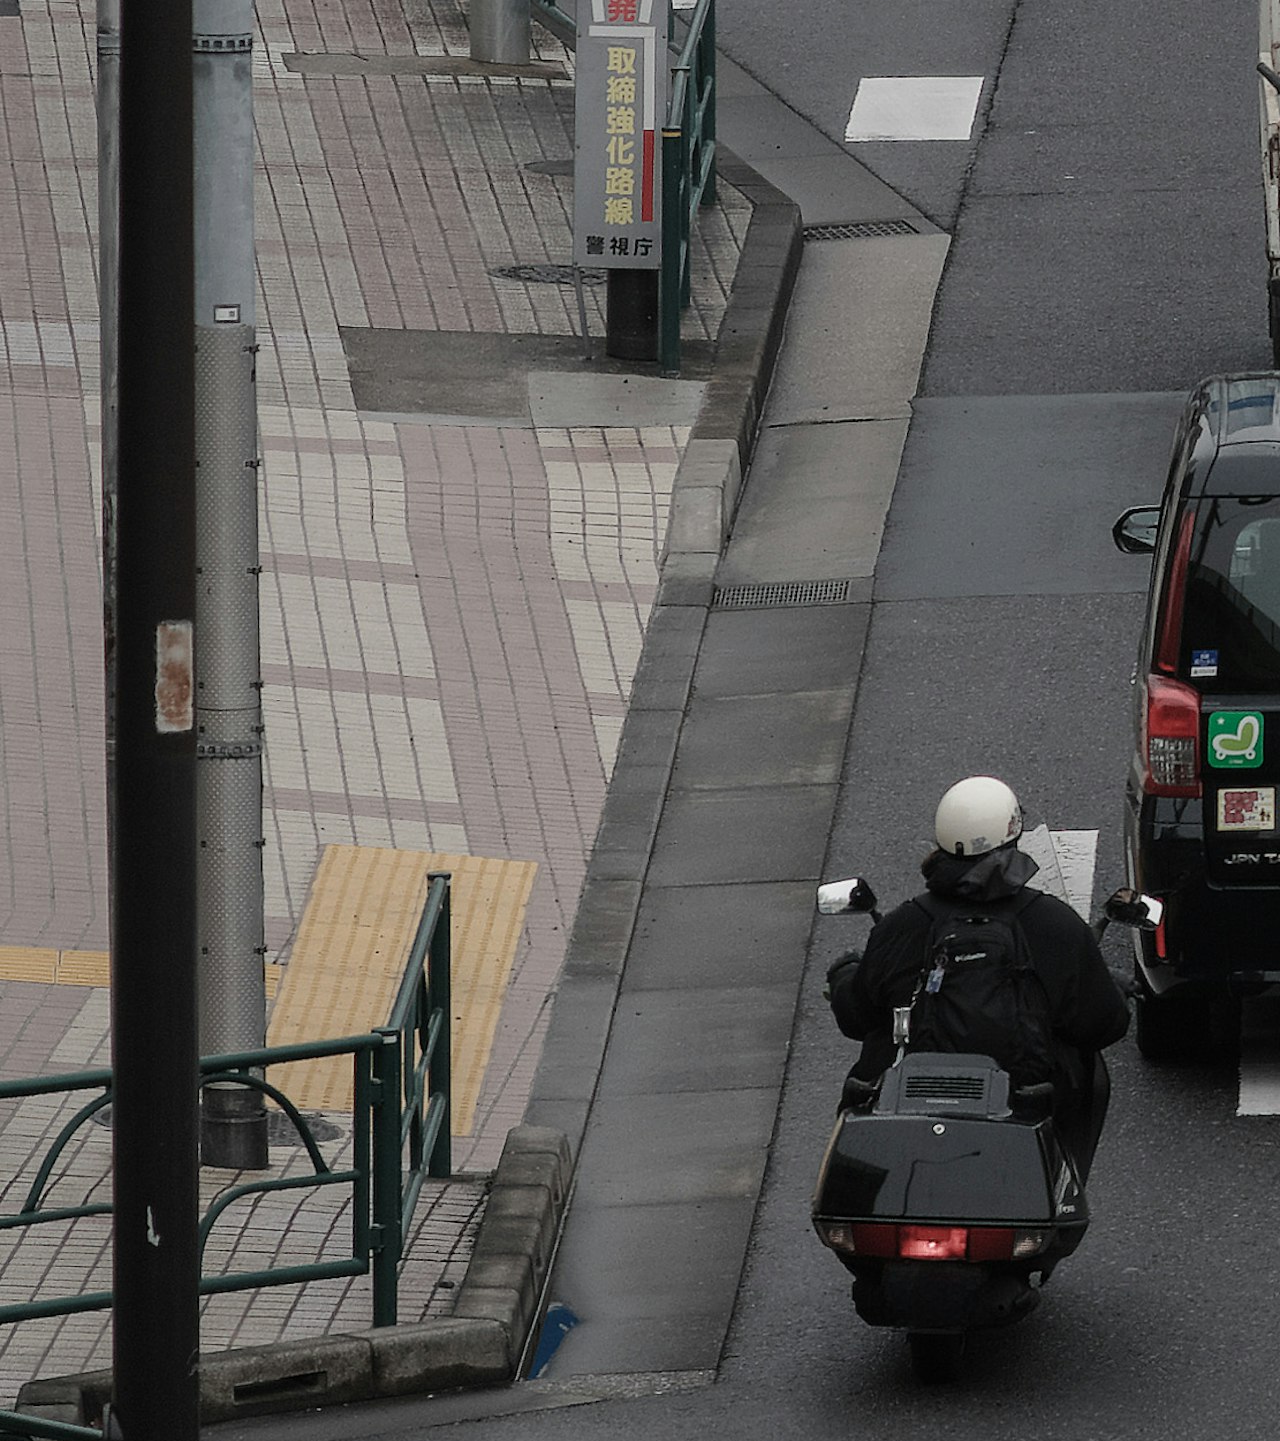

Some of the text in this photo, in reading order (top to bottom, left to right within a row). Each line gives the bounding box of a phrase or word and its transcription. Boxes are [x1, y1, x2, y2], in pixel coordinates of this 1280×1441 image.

[603, 46, 637, 226] 取締強化路線
[585, 235, 654, 257] 警視庁
[1223, 853, 1261, 865] JPN
